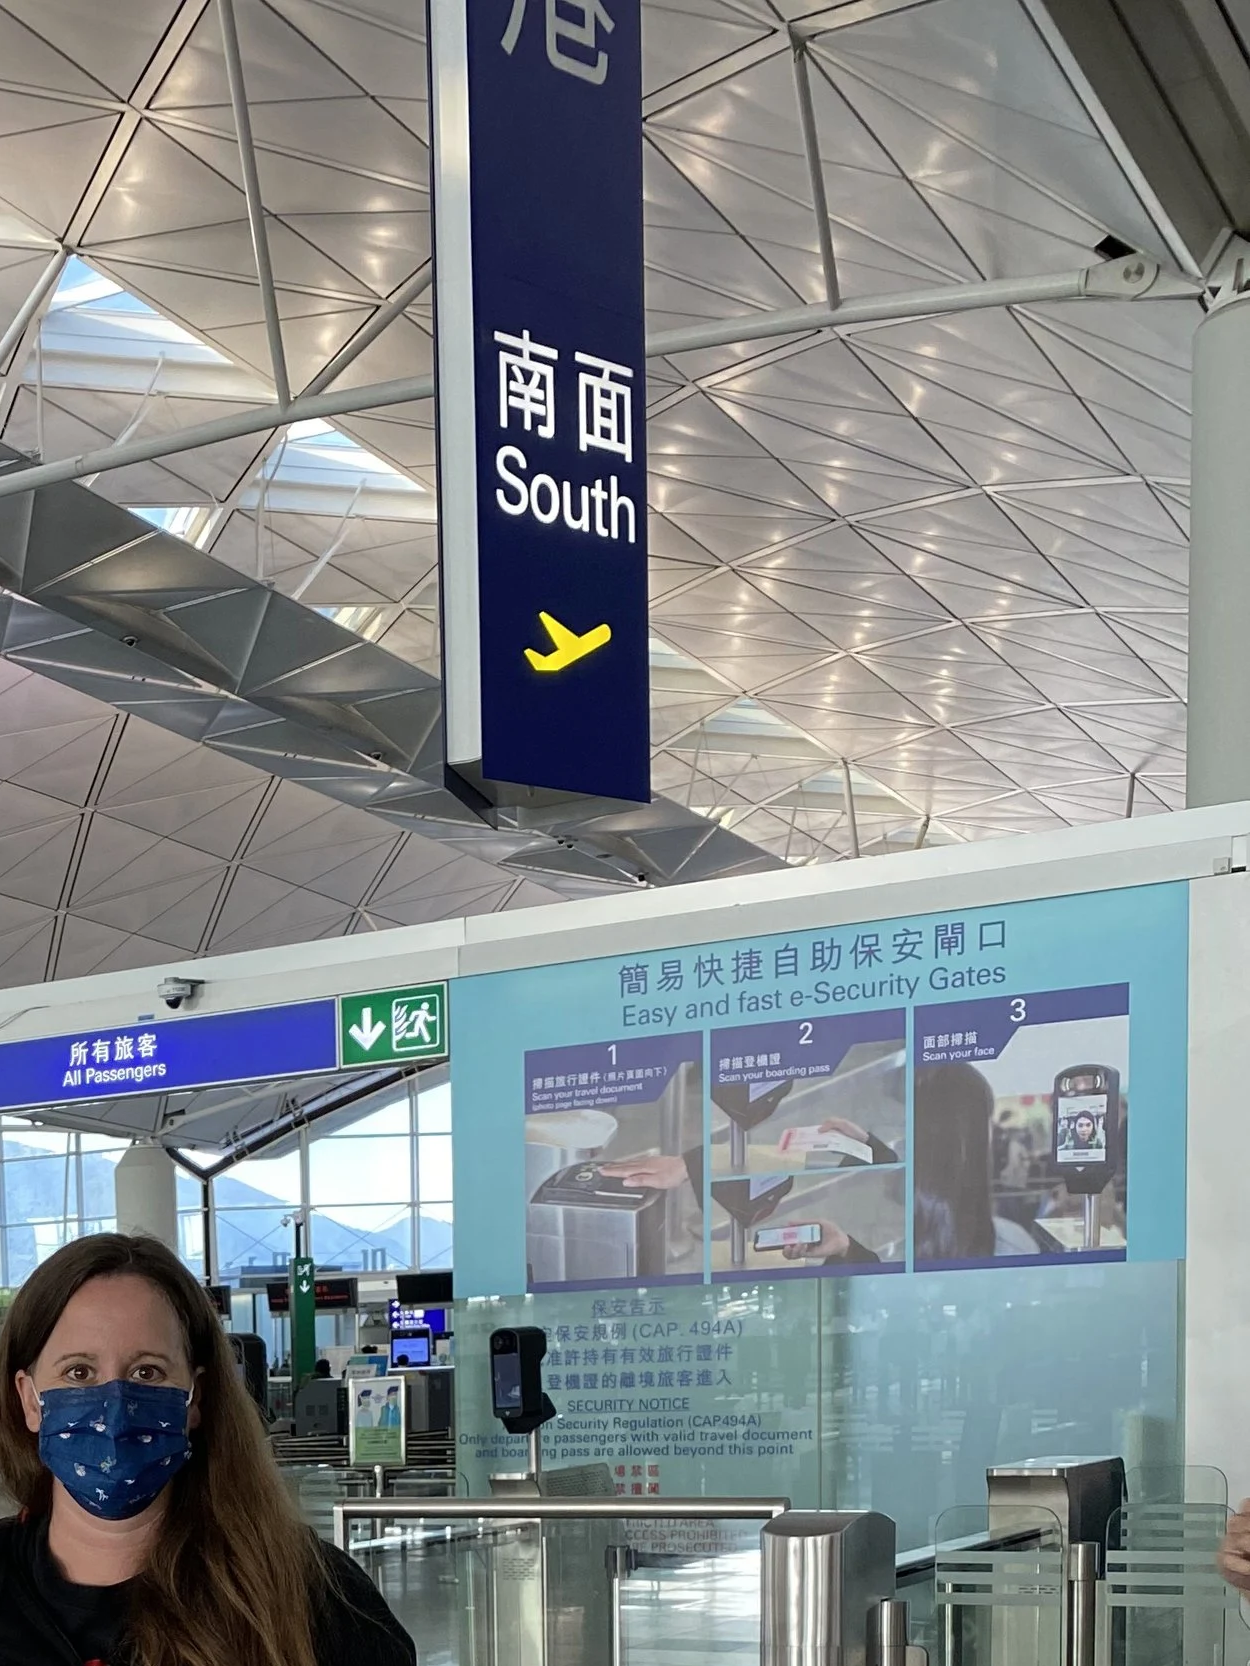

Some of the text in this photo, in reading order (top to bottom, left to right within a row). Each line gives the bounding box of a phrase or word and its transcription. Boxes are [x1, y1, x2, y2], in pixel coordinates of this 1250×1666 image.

[493, 329, 634, 464] 南面
[495, 445, 637, 544] South
[617, 919, 1007, 998] 簡易快捷自助保安閘口
[622, 964, 1007, 1027] Easy and fast e-Security Gates
[1009, 998, 1027, 1022] 3
[798, 1022, 814, 1045] 2
[923, 1031, 978, 1050] 面部掃描
[68, 1033, 158, 1067] 所有旅客
[607, 1044, 617, 1066] 1
[922, 1046, 995, 1062] Scan your face
[718, 1053, 781, 1072] 掃描登機證
[62, 1063, 167, 1087] All Passengers
[718, 1064, 830, 1083] Scan your boarding pass
[532, 1082, 643, 1102] Scan your travel document
[591, 1297, 666, 1317] 保安告示
[542, 1344, 733, 1367] 准許持有有效旅行證件
[567, 1397, 690, 1412] SECURITY NOTICE
[557, 1418, 609, 1431] Security
[613, 1416, 684, 1431] Regulation
[459, 1433, 490, 1447] Only
[554, 1432, 627, 1446] passengers
[630, 1431, 659, 1442] with
[663, 1430, 696, 1442] valid
[700, 1430, 738, 1441] travel
[742, 1429, 813, 1441] document
[475, 1447, 498, 1458] and
[561, 1447, 590, 1459] pass
[594, 1446, 615, 1457] are
[618, 1445, 669, 1456] allowed
[674, 1444, 724, 1458] beyond
[728, 1443, 754, 1455] this
[758, 1444, 794, 1457] point
